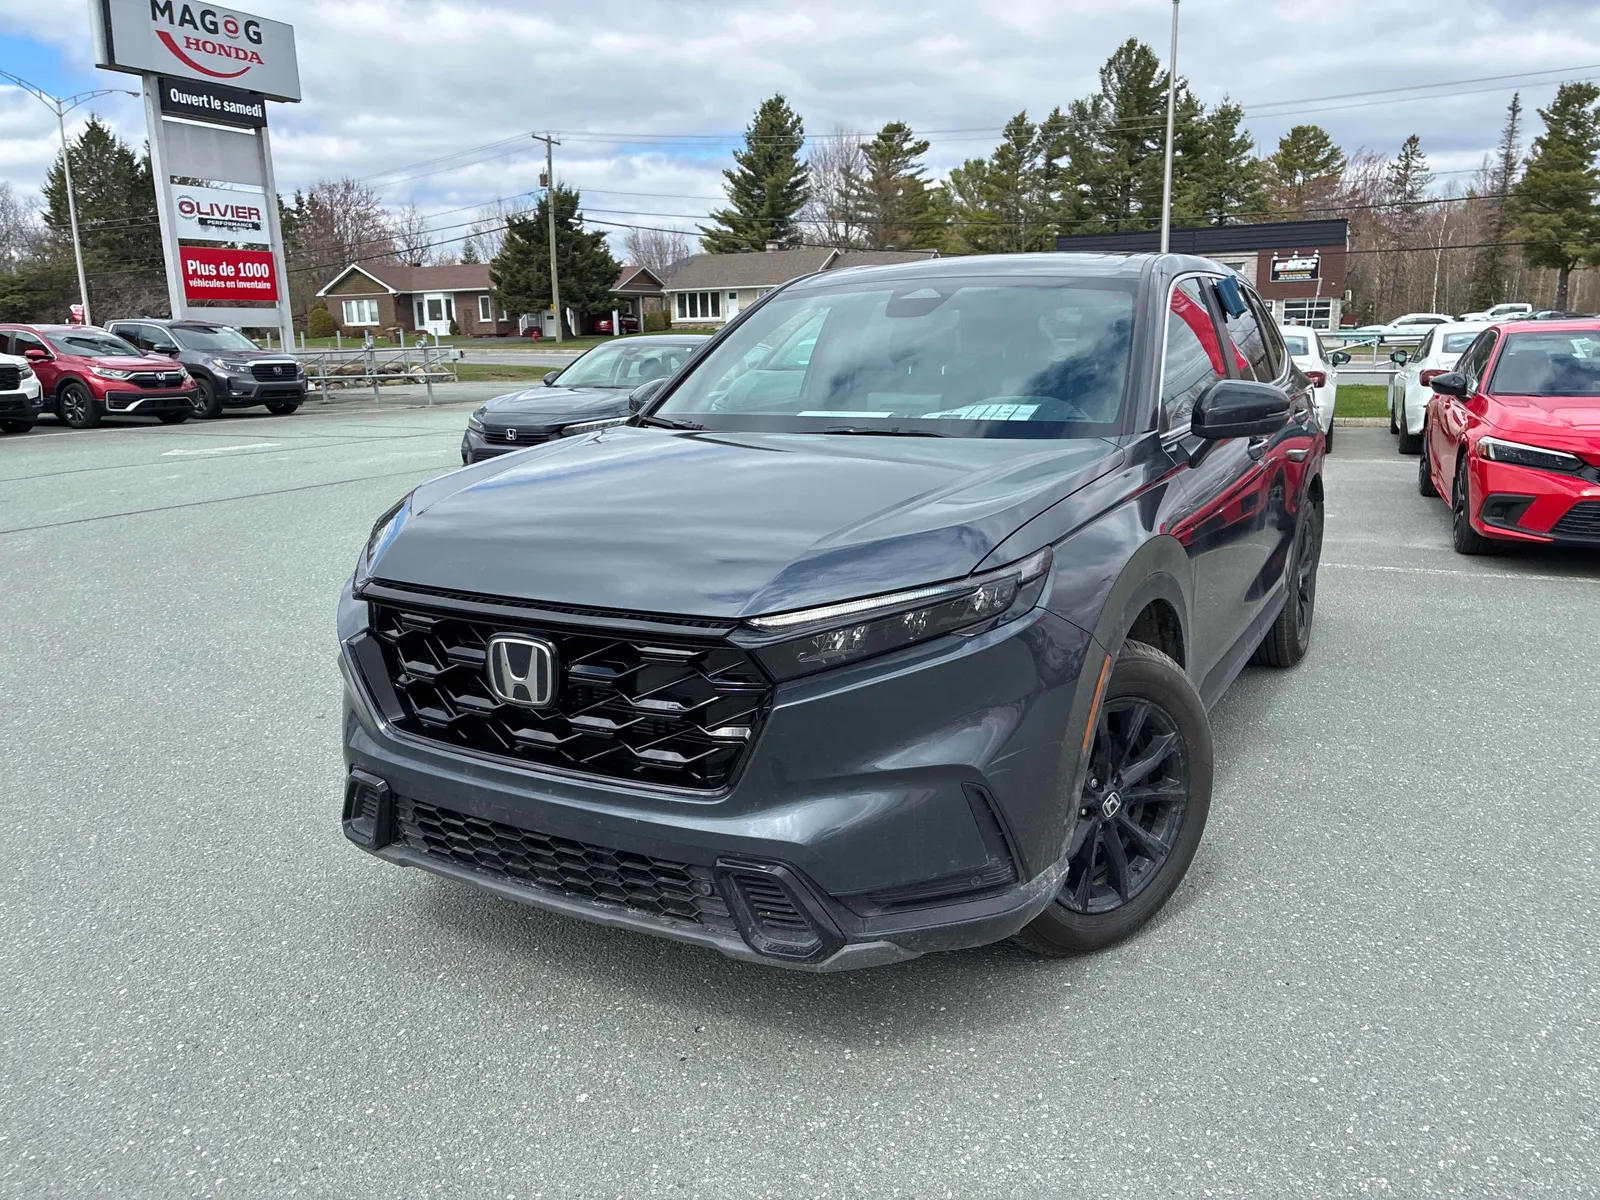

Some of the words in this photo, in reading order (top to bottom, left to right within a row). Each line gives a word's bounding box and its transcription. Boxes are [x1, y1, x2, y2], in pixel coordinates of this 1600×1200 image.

[150, 0, 263, 45] MAGOG
[183, 35, 265, 65] HONDA
[170, 88, 209, 109] Ouvert
[210, 95, 222, 110] le
[223, 101, 263, 118] samedi
[178, 200, 261, 221] OLIVIER
[207, 219, 253, 228] PERFORMANCE
[186, 259, 217, 276] Plus
[219, 261, 235, 277] de
[238, 262, 270, 278] 1000
[188, 278, 225, 288] véhicules
[237, 279, 271, 289] inventaire
